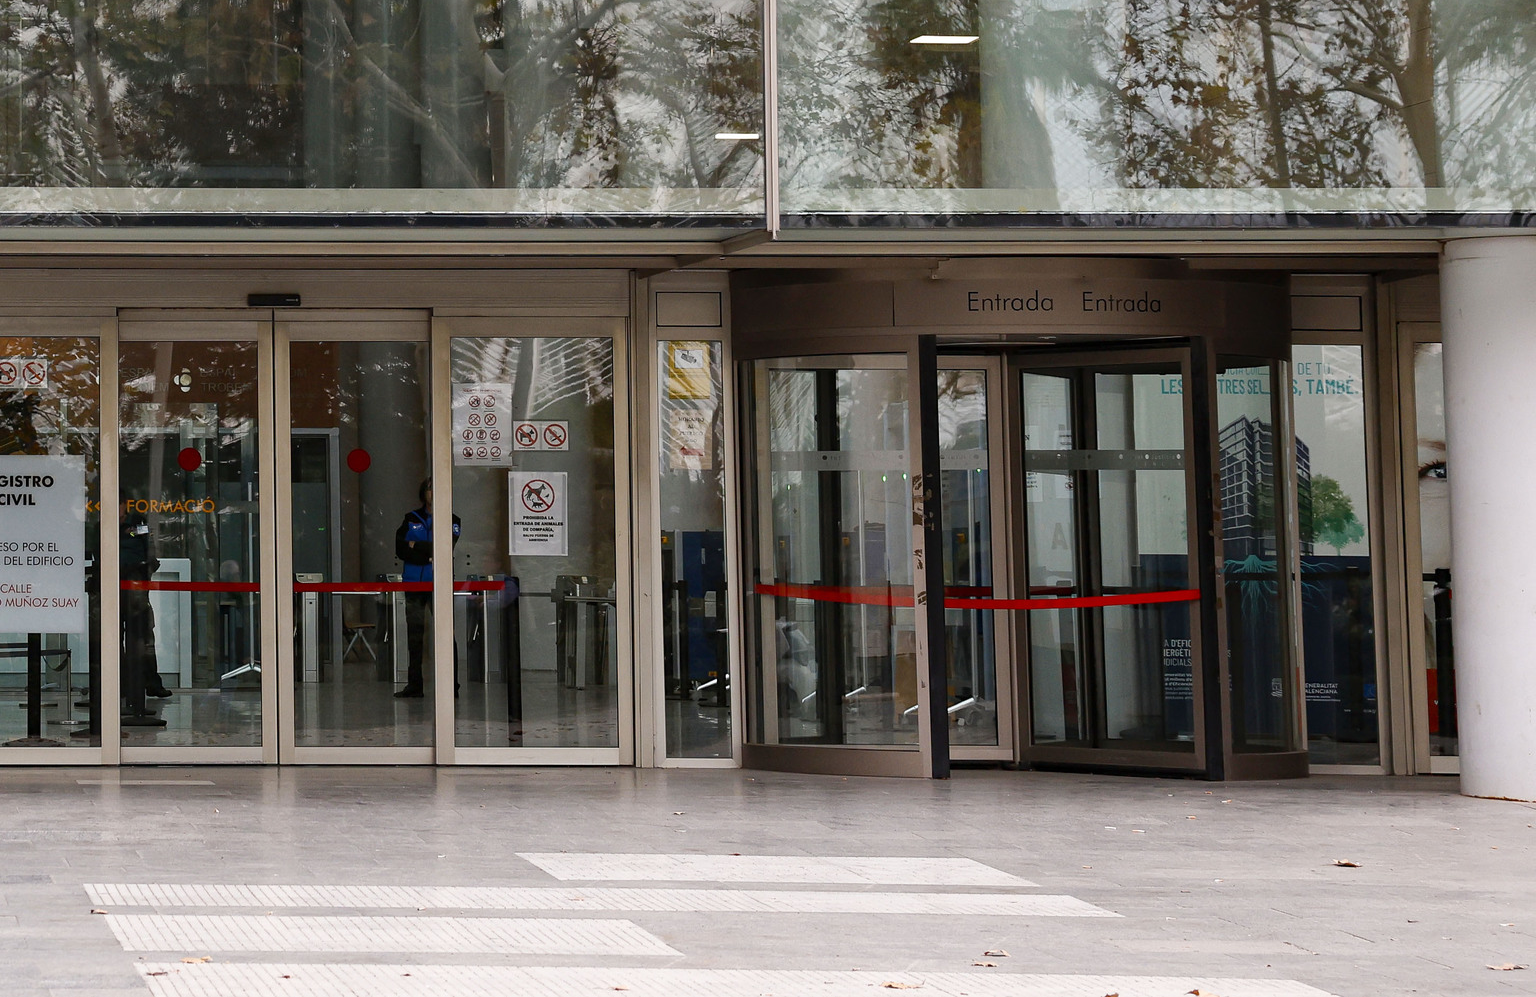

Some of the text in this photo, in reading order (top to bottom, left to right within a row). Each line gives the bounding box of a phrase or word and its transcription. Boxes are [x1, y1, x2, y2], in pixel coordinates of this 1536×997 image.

[968, 290, 1162, 313] Entrada Entrada
[126, 497, 216, 513] FORMACIÓ
[22, 542, 44, 552] POR
[47, 542, 59, 552] EL
[4, 556, 24, 566] DEL
[26, 556, 74, 566] EDIFICIO
[0, 584, 32, 594] CALLE
[5, 595, 49, 608] MUÑOZ
[51, 597, 80, 608] SUAY
[1163, 658, 1192, 666] DICIALS
